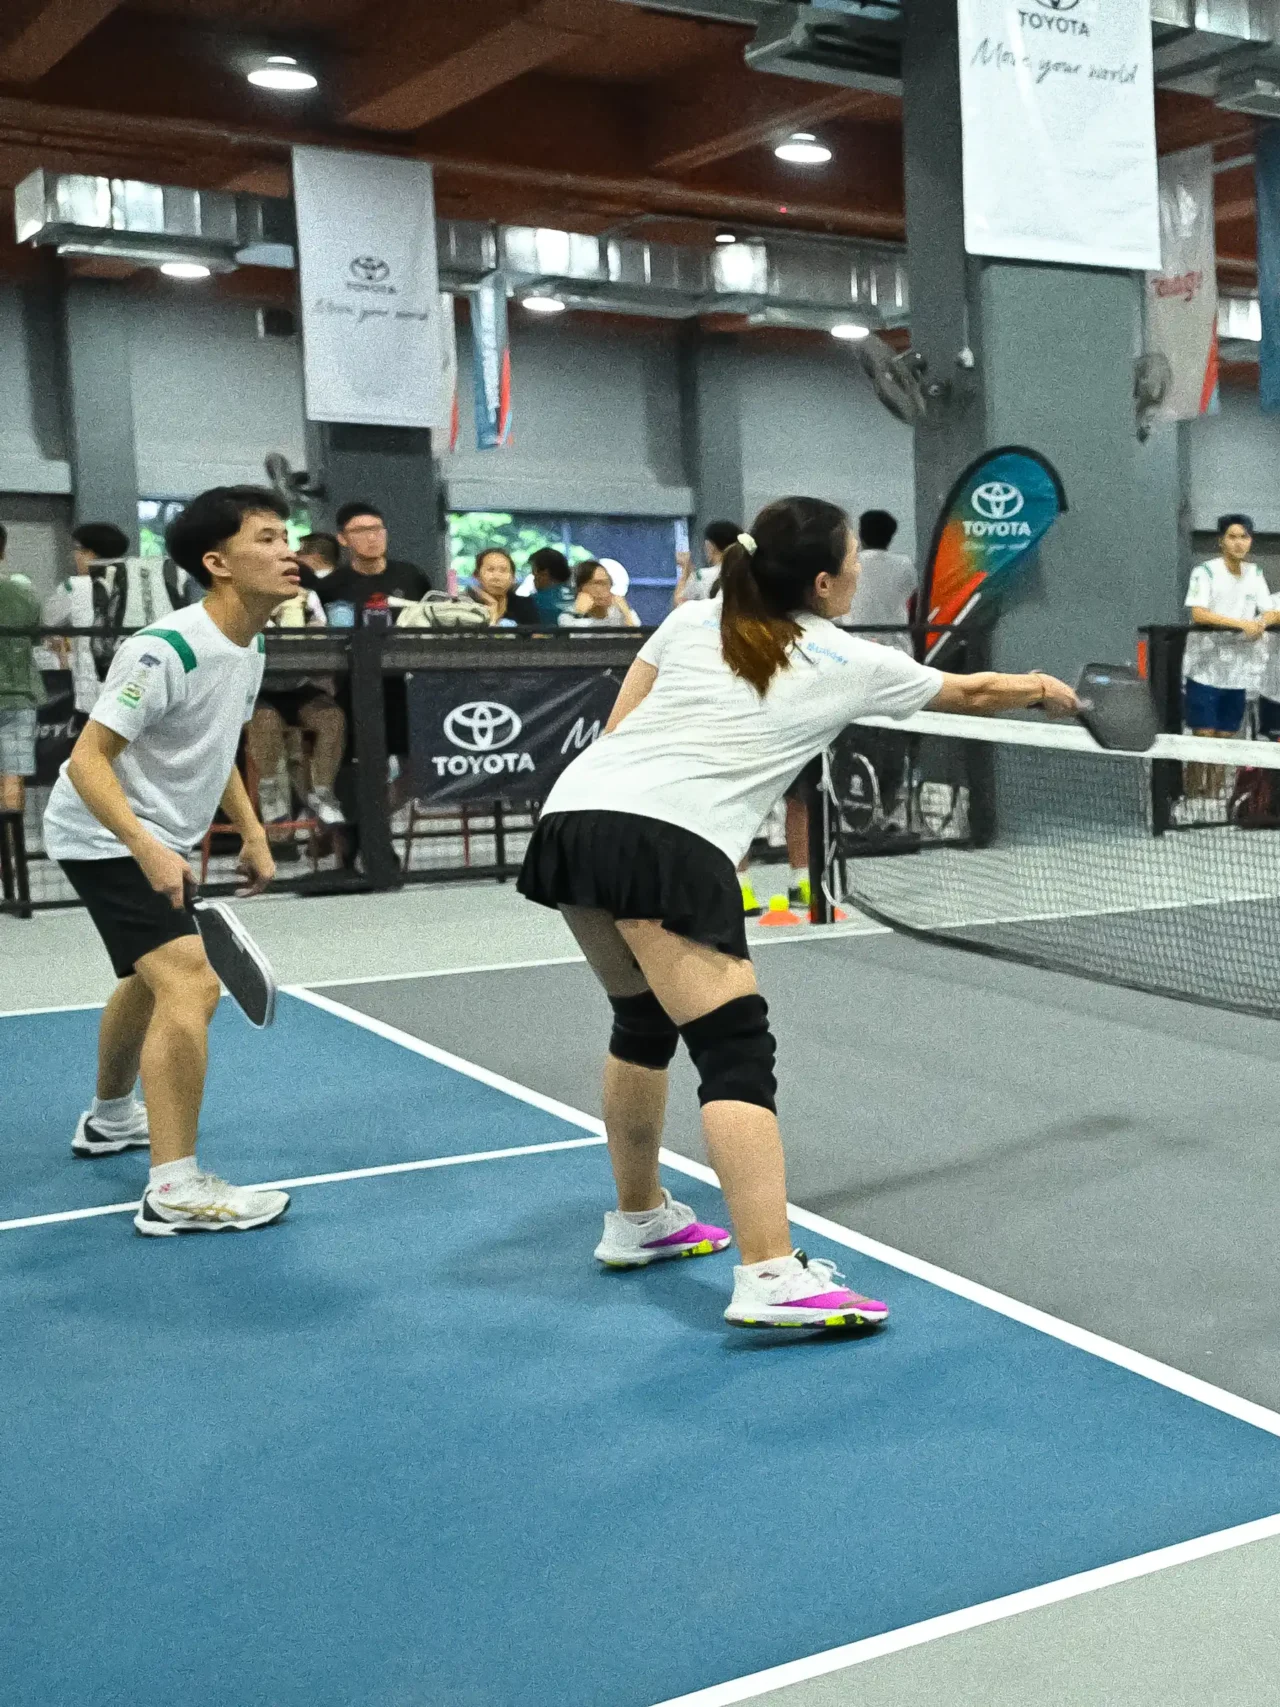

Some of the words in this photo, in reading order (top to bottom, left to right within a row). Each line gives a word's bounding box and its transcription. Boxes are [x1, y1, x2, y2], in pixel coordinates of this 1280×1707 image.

[1018, 10, 1090, 37] TOYOTA
[1036, 60, 1082, 84] your
[1088, 64, 1138, 84] world
[962, 521, 1031, 537] TOYOTA
[431, 752, 536, 776] TOYOTA
